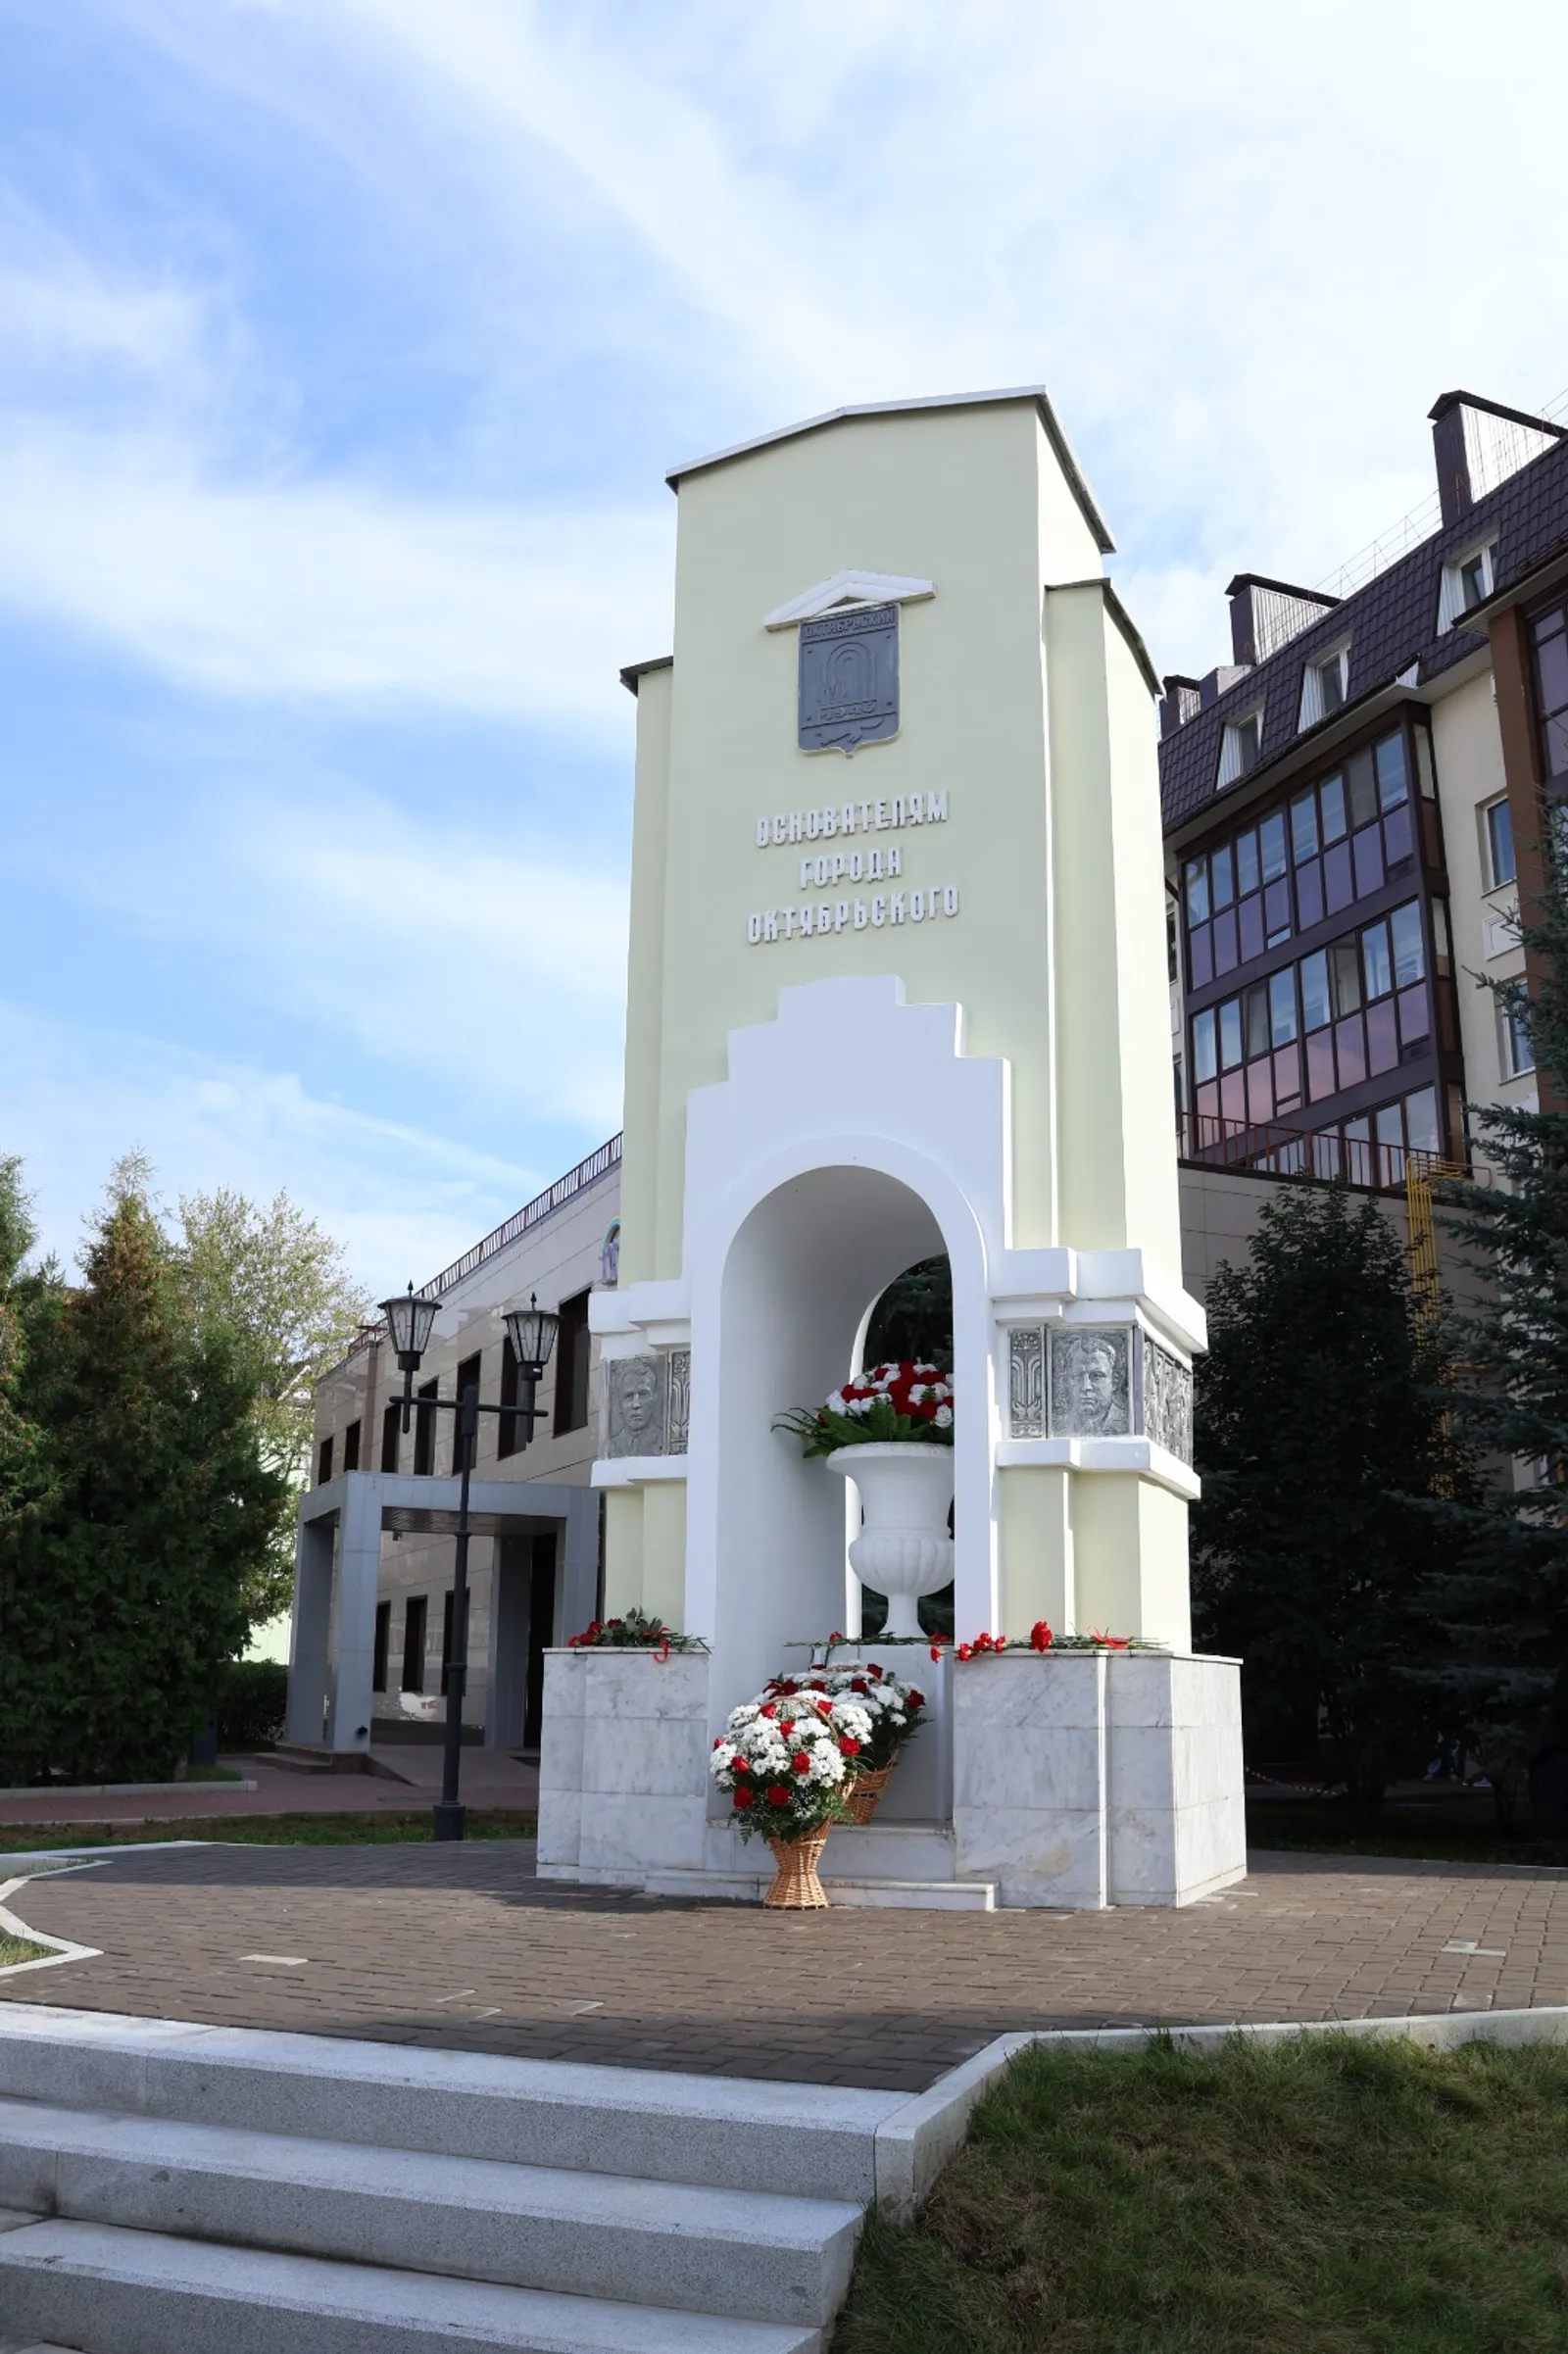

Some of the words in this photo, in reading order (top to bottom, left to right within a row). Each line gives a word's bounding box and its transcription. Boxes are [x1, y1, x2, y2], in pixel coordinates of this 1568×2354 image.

[756, 789, 949, 848] ОСНОВАТЕЛЯМ
[800, 847, 902, 890] ГОРОДА
[747, 885, 958, 945] ОКТЯБРЬСКОГО
